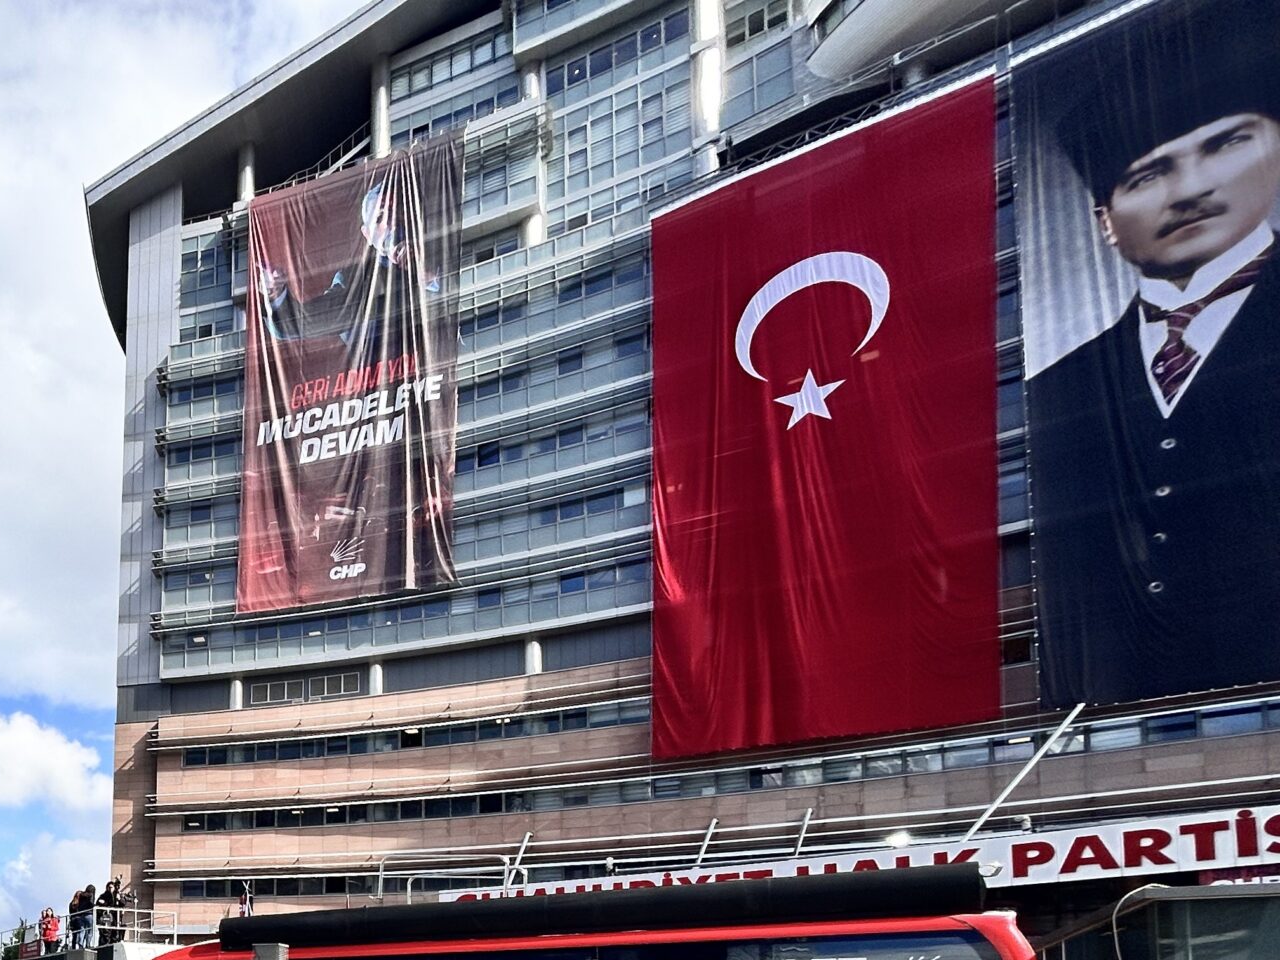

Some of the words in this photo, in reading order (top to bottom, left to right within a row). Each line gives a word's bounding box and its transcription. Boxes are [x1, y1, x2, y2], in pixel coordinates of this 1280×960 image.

[291, 375, 331, 409] GERİ
[333, 361, 384, 397] ADIM
[257, 374, 444, 447] MÜCADELEYE
[299, 414, 405, 464] DEVAM
[329, 562, 366, 580] CHP
